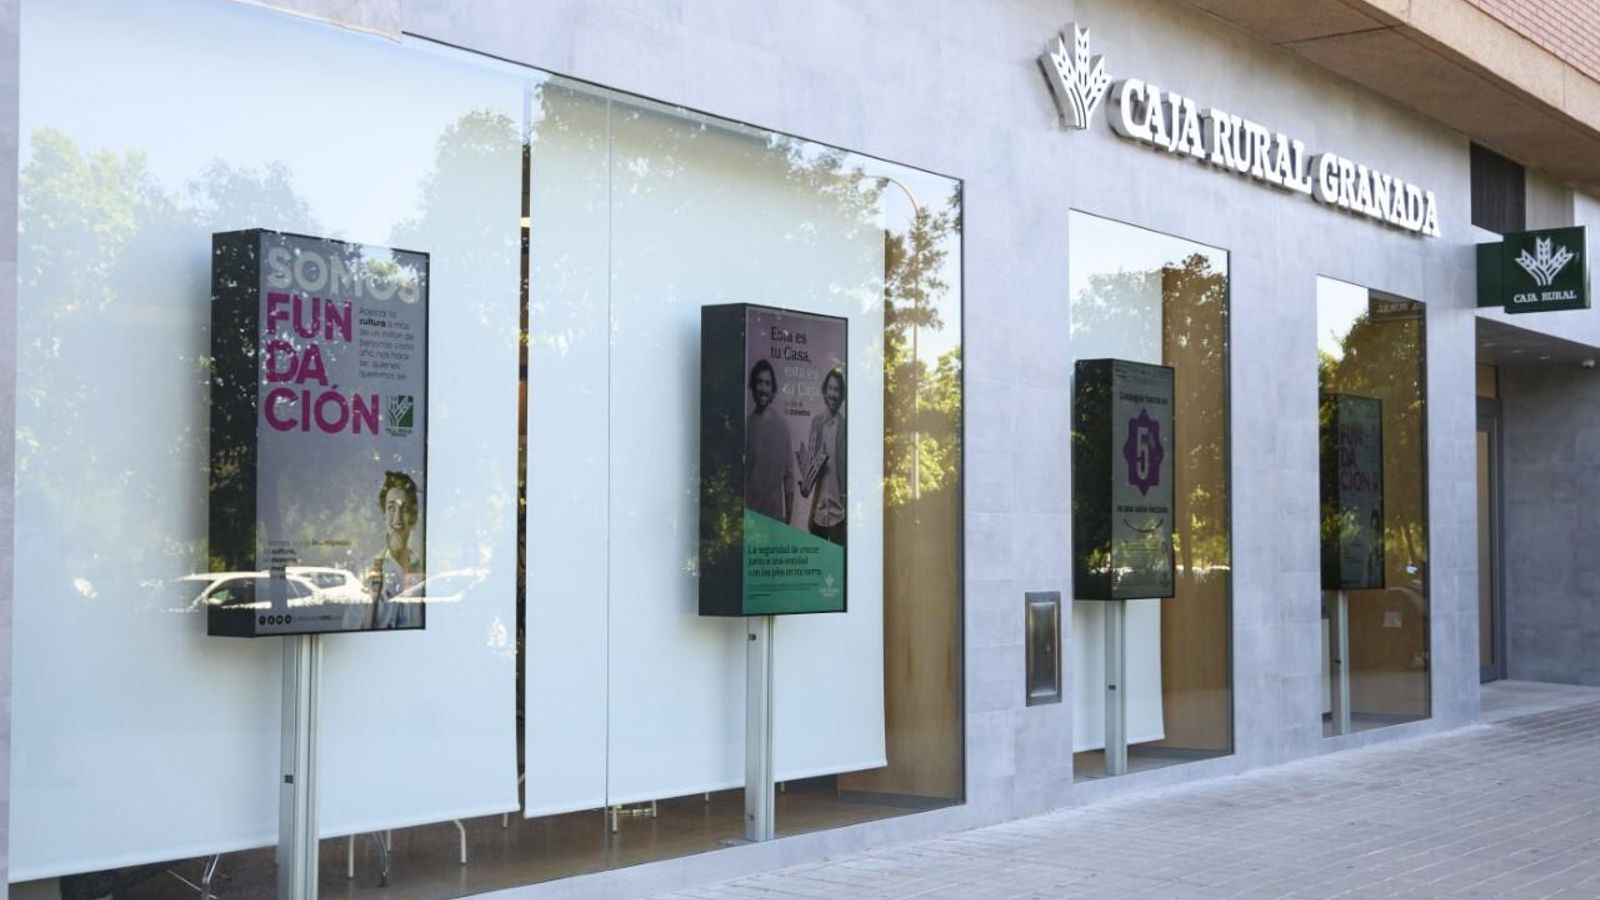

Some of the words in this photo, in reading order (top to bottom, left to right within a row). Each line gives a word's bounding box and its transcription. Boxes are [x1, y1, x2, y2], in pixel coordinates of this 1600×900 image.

[1120, 77, 1206, 159] CAJA
[1210, 107, 1312, 195] RURAL
[1319, 152, 1441, 238] GRANADA
[267, 247, 420, 304] SOMOS
[1513, 293, 1538, 303] CAJA
[1541, 290, 1577, 301] RURAL
[266, 292, 353, 343] FUN
[359, 319, 386, 328] cultura
[770, 345, 781, 359] tu
[795, 332, 807, 345] es
[265, 339, 329, 387] DA
[264, 384, 380, 436] CIÓN
[748, 544, 757, 554] La
